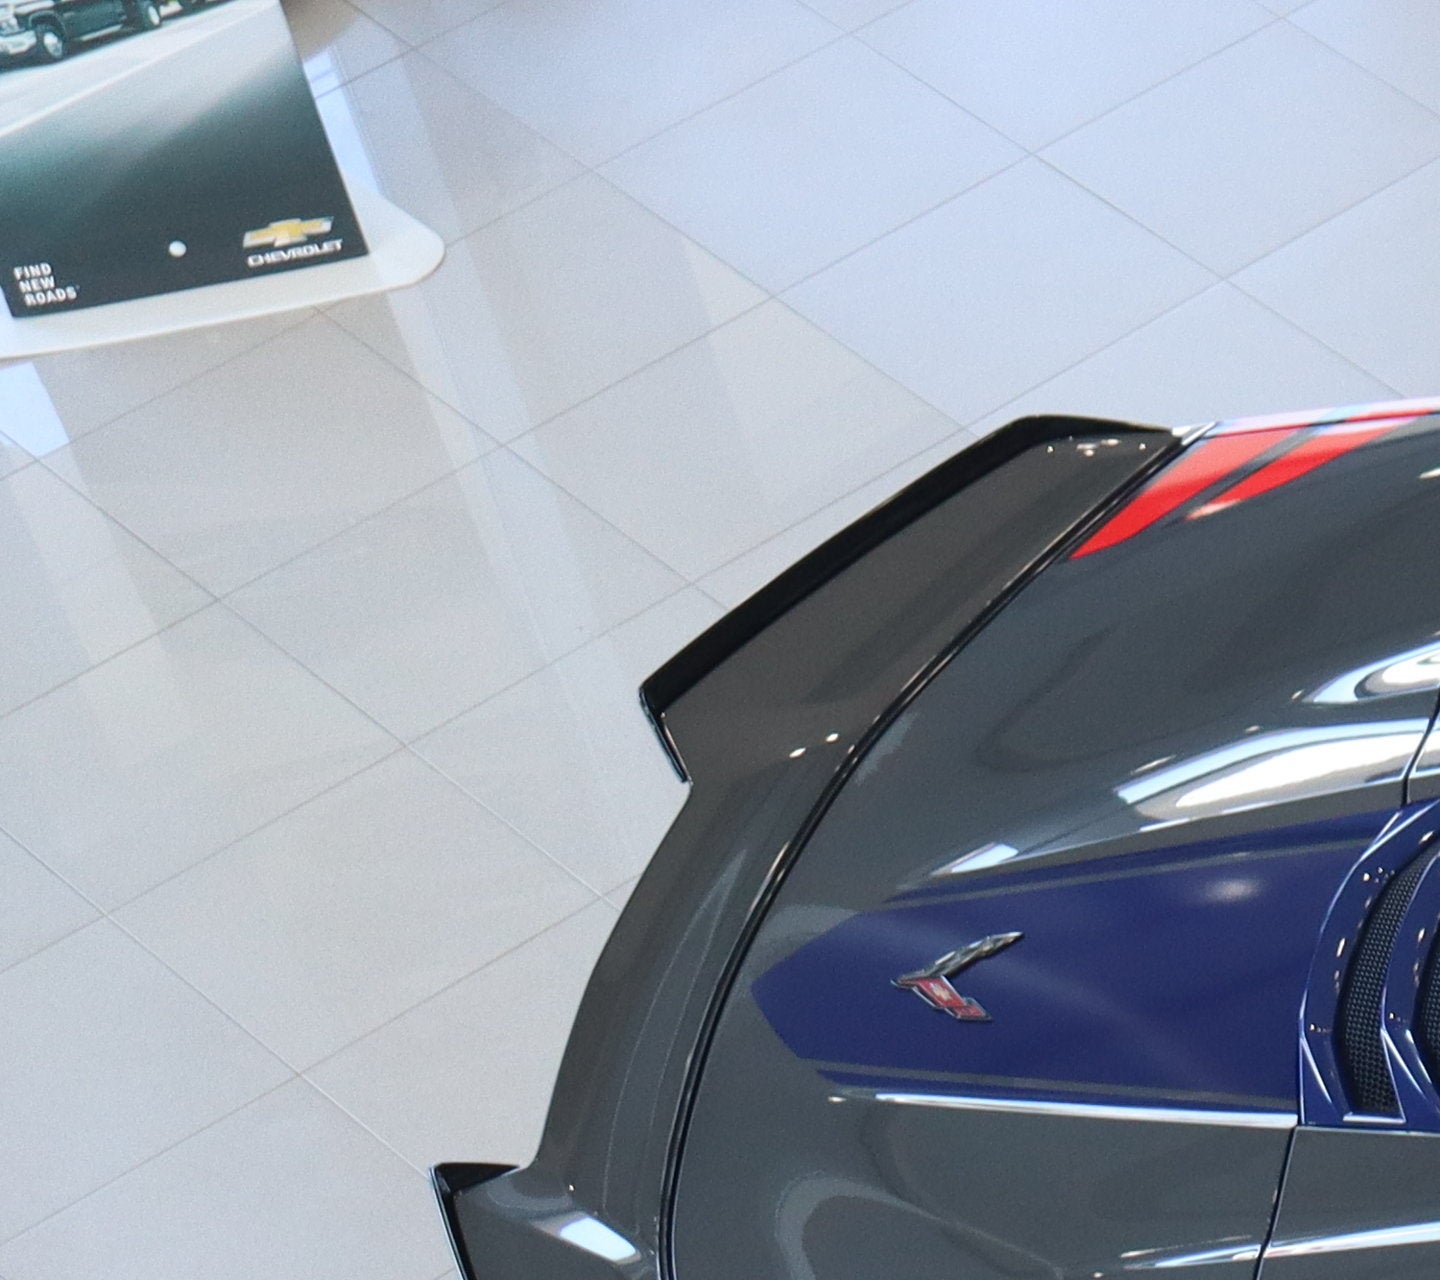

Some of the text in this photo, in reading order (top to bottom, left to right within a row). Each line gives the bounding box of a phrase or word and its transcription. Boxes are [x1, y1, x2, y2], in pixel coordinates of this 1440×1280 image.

[247, 238, 343, 268] CHEVROLET
[13, 262, 52, 280] FIND
[19, 275, 56, 293] NEW
[24, 286, 77, 306] ROADS
